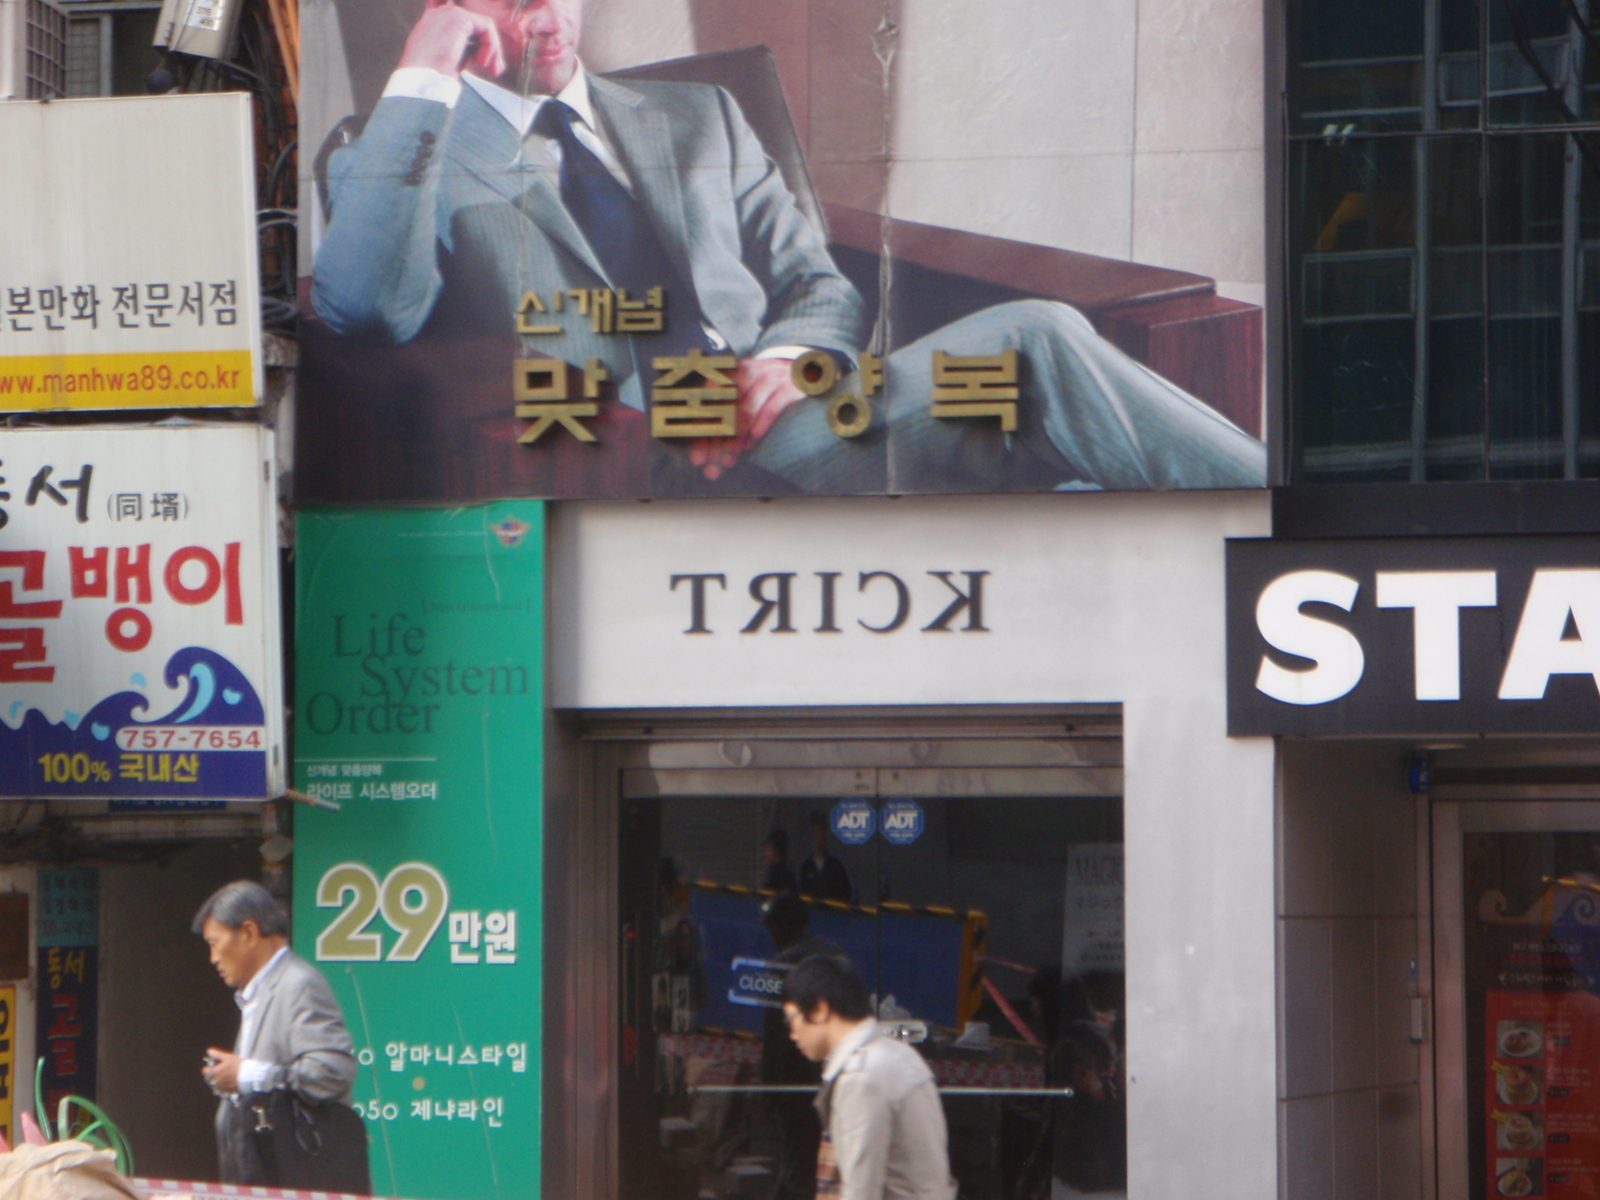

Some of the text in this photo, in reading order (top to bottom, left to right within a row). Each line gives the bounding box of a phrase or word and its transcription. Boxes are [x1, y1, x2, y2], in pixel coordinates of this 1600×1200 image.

[0, 280, 237, 331] 본만화 전문서점
[516, 286, 664, 335] 신개념
[334, 612, 427, 657] Life
[1255, 567, 1600, 706] STA
[361, 654, 530, 702] System
[305, 690, 441, 736] Order
[123, 729, 261, 749] 757-7654
[37, 752, 200, 784] 100% 국내산
[306, 781, 437, 801] 라이프 시스템오더
[838, 809, 870, 829] ADT
[884, 809, 918, 829] ADT
[385, 1042, 528, 1073] 알마니스타일
[411, 1098, 504, 1128] 제냐라인
